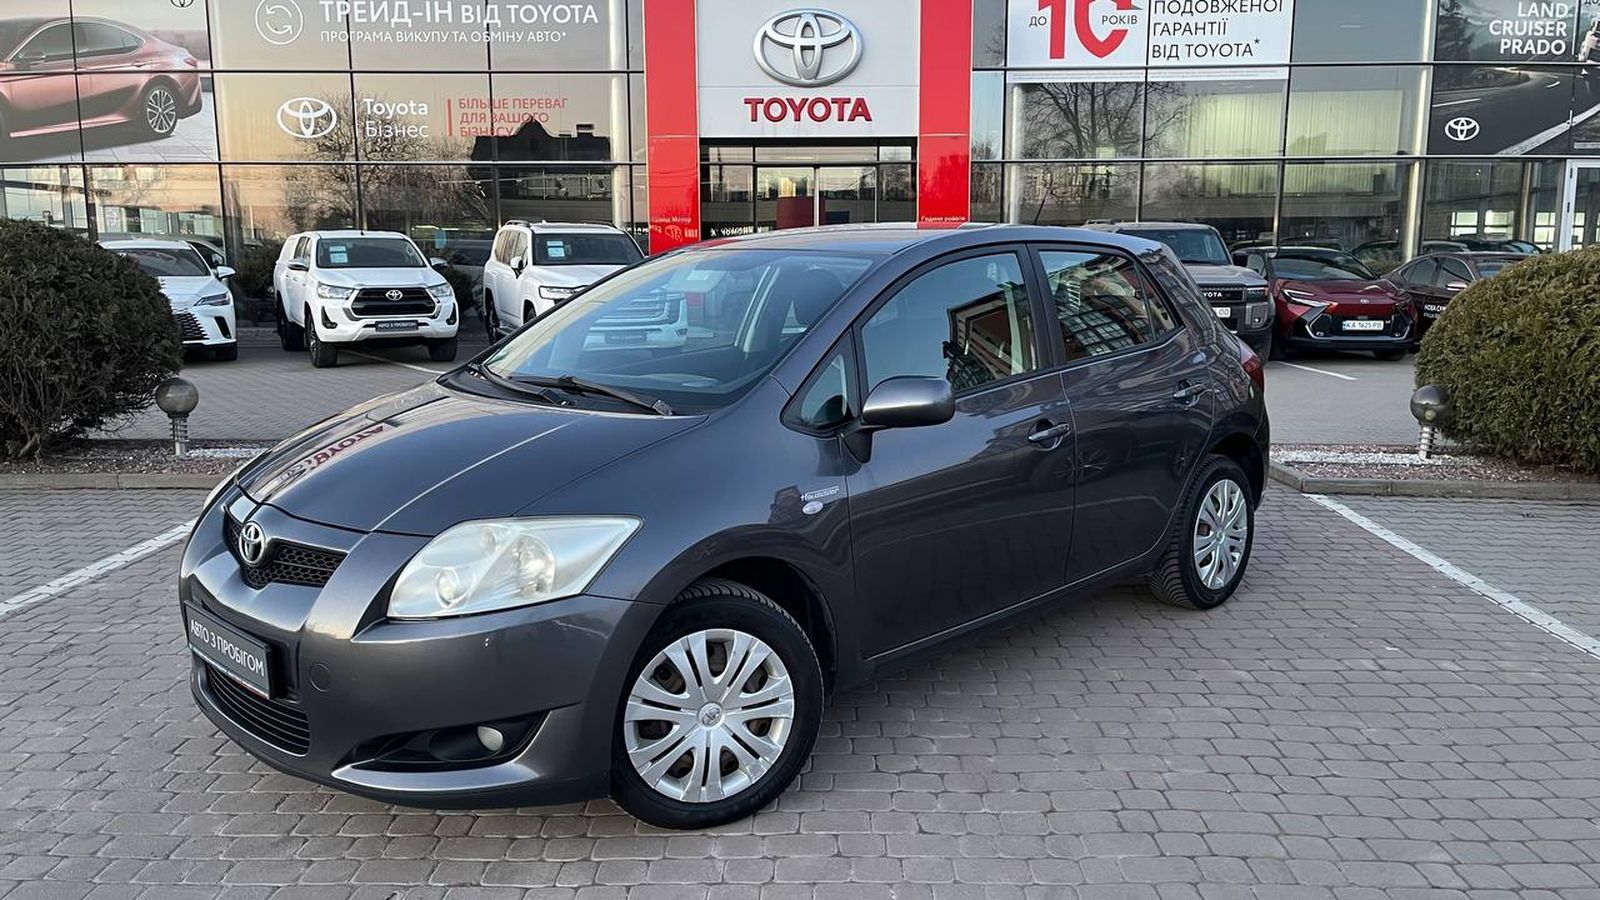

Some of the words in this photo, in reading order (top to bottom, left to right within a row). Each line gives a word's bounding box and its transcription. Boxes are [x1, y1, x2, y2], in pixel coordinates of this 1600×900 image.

[461, 4, 500, 28] ВІД
[506, 4, 599, 24] TOYOTA
[1518, 2, 1568, 18] LAND
[1029, 16, 1047, 28] ДО
[1101, 14, 1138, 26] РОКІВ
[1152, 18, 1229, 37] ГАРАНТІЇ
[1489, 19, 1567, 37] CRUISER
[320, 30, 392, 42] ПРОГРАМА
[396, 30, 450, 42] ВИКУПУ
[452, 31, 468, 42] ТА
[470, 31, 524, 42] ОБМІНУ
[1152, 44, 1180, 61] ВІД
[1500, 38, 1566, 55] PRADO
[364, 98, 428, 119] Toyota
[512, 98, 568, 109] ПЕРЕВАГ
[743, 97, 872, 122] TOYOTA
[460, 112, 487, 125] ДЛЯ
[365, 120, 430, 138] Бізнес
[460, 126, 515, 137] БІЗНСУ
[191, 619, 210, 644] АВТО
[211, 632, 217, 648] З
[217, 635, 265, 677] ПРОБІГОМ
